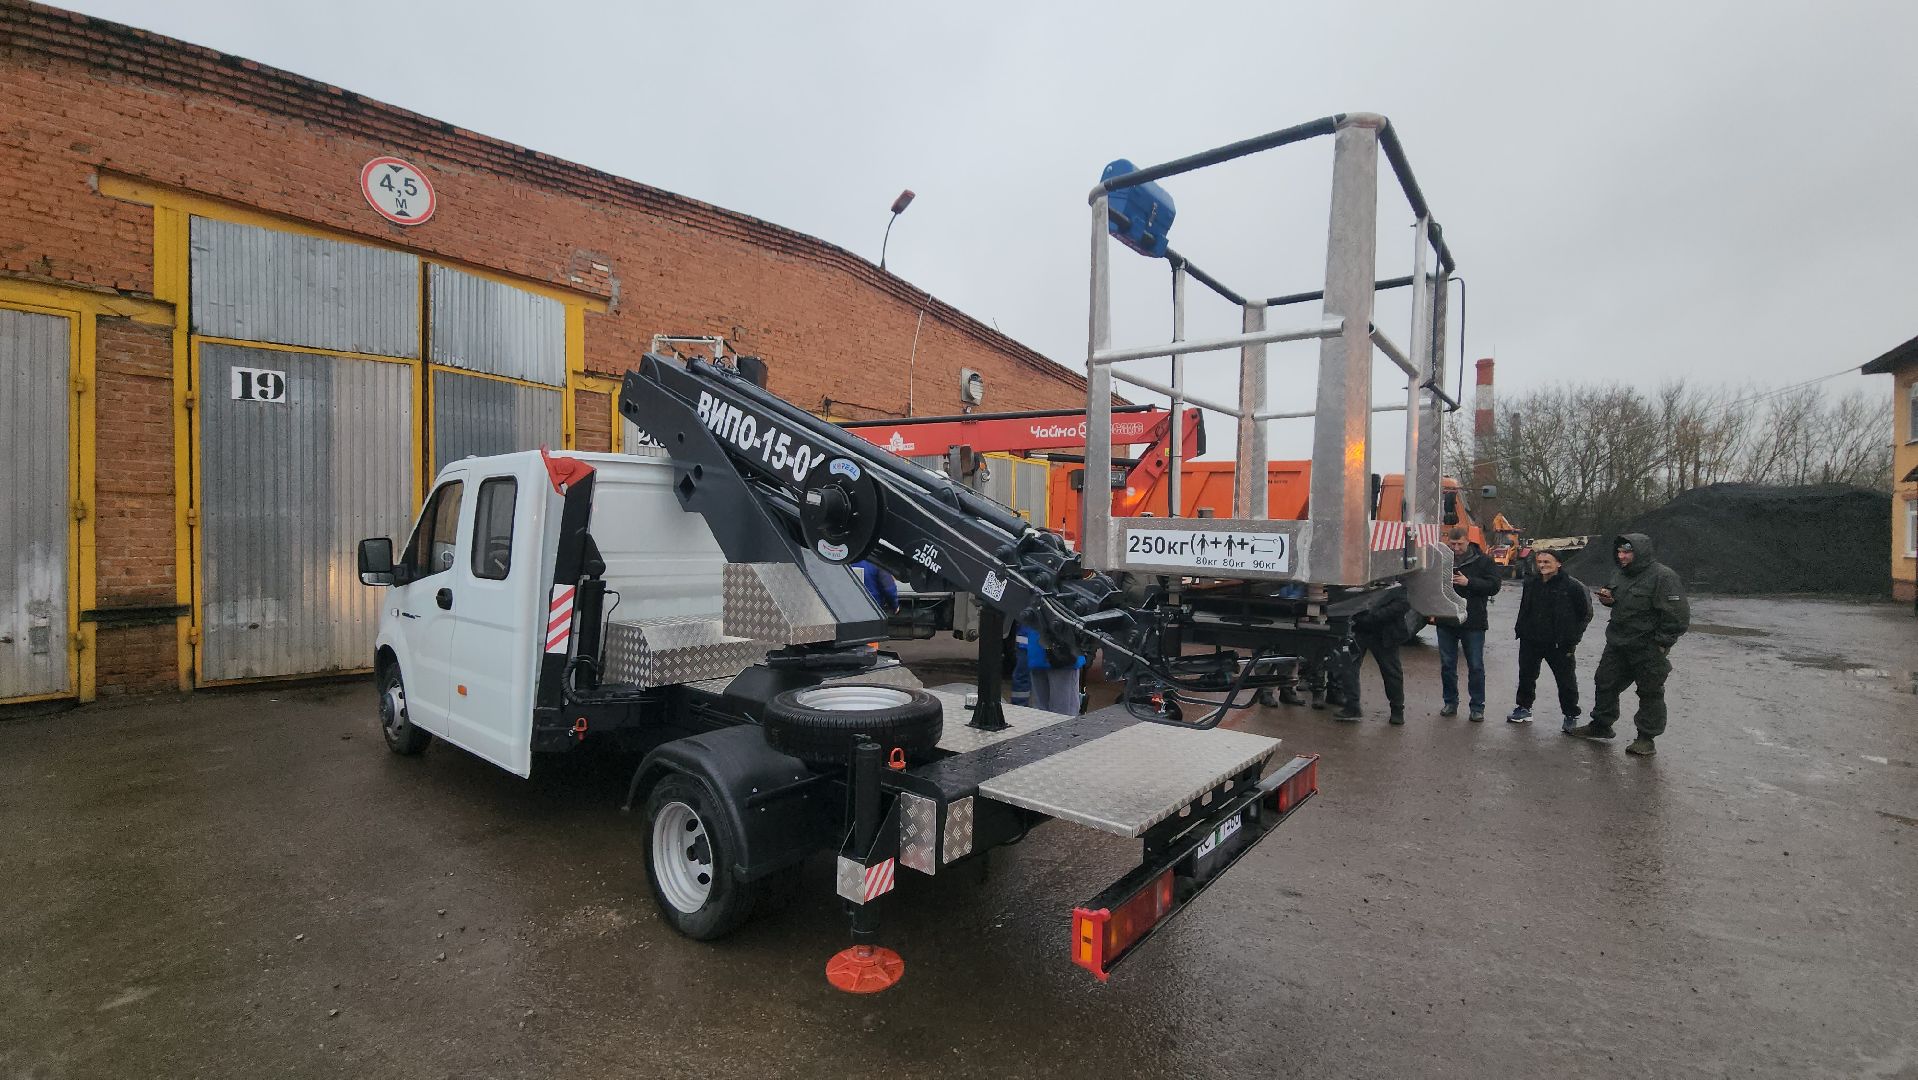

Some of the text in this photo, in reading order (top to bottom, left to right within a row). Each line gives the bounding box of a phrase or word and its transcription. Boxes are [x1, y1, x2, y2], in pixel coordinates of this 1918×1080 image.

[380, 173, 418, 198] 4,5
[395, 198, 408, 209] М
[237, 371, 284, 400] 19
[912, 548, 942, 573] 250кг
[1195, 556, 1276, 570] 80кг 80кг 90кг
